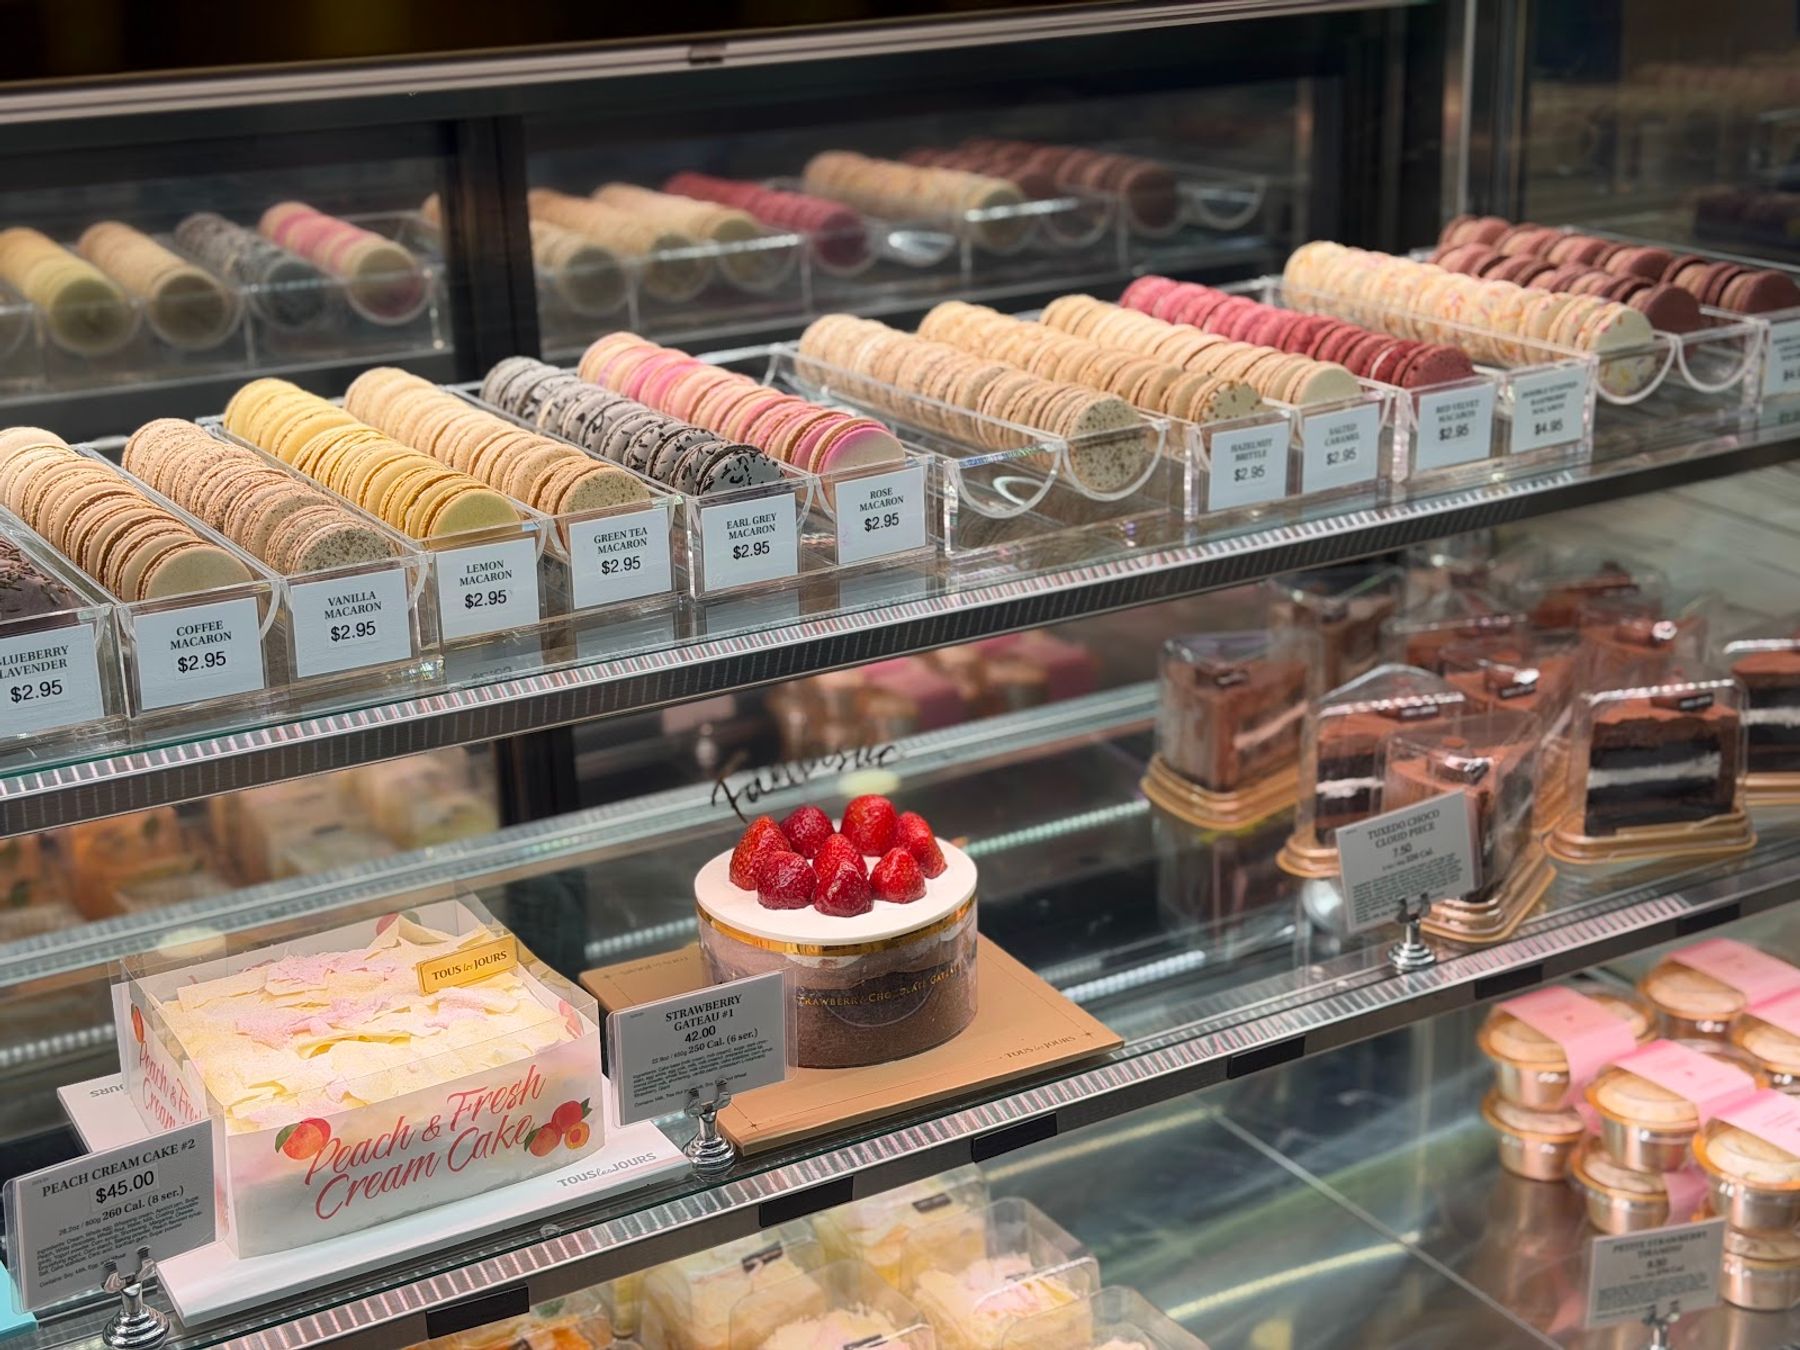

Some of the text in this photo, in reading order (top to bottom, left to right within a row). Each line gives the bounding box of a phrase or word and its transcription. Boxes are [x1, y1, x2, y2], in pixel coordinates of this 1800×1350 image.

[1329, 423, 1357, 436] SALTED
[1439, 424, 1469, 441] $2.95
[1535, 418, 1563, 435] $4.95
[1231, 438, 1273, 453] HAZELNUT
[1325, 432, 1360, 447] CARAMEL
[1235, 450, 1267, 462] BRITTLE
[1326, 447, 1357, 466] $2.95
[1234, 465, 1265, 482] $2.95
[870, 487, 894, 500] ROSE
[859, 495, 904, 513] MACARON
[726, 512, 778, 530] EARL GREY
[864, 512, 900, 533] $2.95
[593, 526, 648, 546] GREEN TEA
[728, 522, 776, 541] MACARON
[598, 537, 648, 555] MACARON
[733, 540, 771, 560] $2.95
[466, 559, 505, 574] LEMON
[601, 555, 641, 576] $2.95
[459, 569, 513, 587] MACARON
[327, 590, 377, 607] VANILLA
[465, 589, 507, 609] $2.95
[324, 600, 383, 620] MACARON
[176, 620, 224, 637] COFFEE
[330, 620, 377, 642] $2.95
[170, 631, 232, 651] MACARON
[177, 650, 227, 673] $2.95
[10, 679, 64, 703] $2.95
[1368, 809, 1440, 840] TUXEDO CHOCO
[1375, 822, 1435, 849] CLOUD PIECE
[432, 950, 507, 980] TOUS les JOURS
[665, 993, 743, 1022] STRAWBERRY
[674, 1008, 734, 1032] GATEAU #1
[684, 1025, 716, 1043] 42.00
[688, 1043, 705, 1054] 250
[706, 1037, 725, 1049] Cal.
[727, 1034, 737, 1045] (6
[738, 1027, 758, 1041] ser.)
[304, 1064, 547, 1186] Peach & Fresh
[42, 1138, 196, 1197] PEACH CREAM CAKE #2
[315, 1114, 535, 1220] Cream Cake
[557, 1169, 597, 1187] TOUS
[610, 1152, 656, 1171] JOURS
[95, 1170, 155, 1204] $45.00
[102, 1207, 122, 1220] 260
[124, 1199, 145, 1213] Cal.
[147, 1194, 159, 1207] (8
[161, 1185, 184, 1201] ser.)
